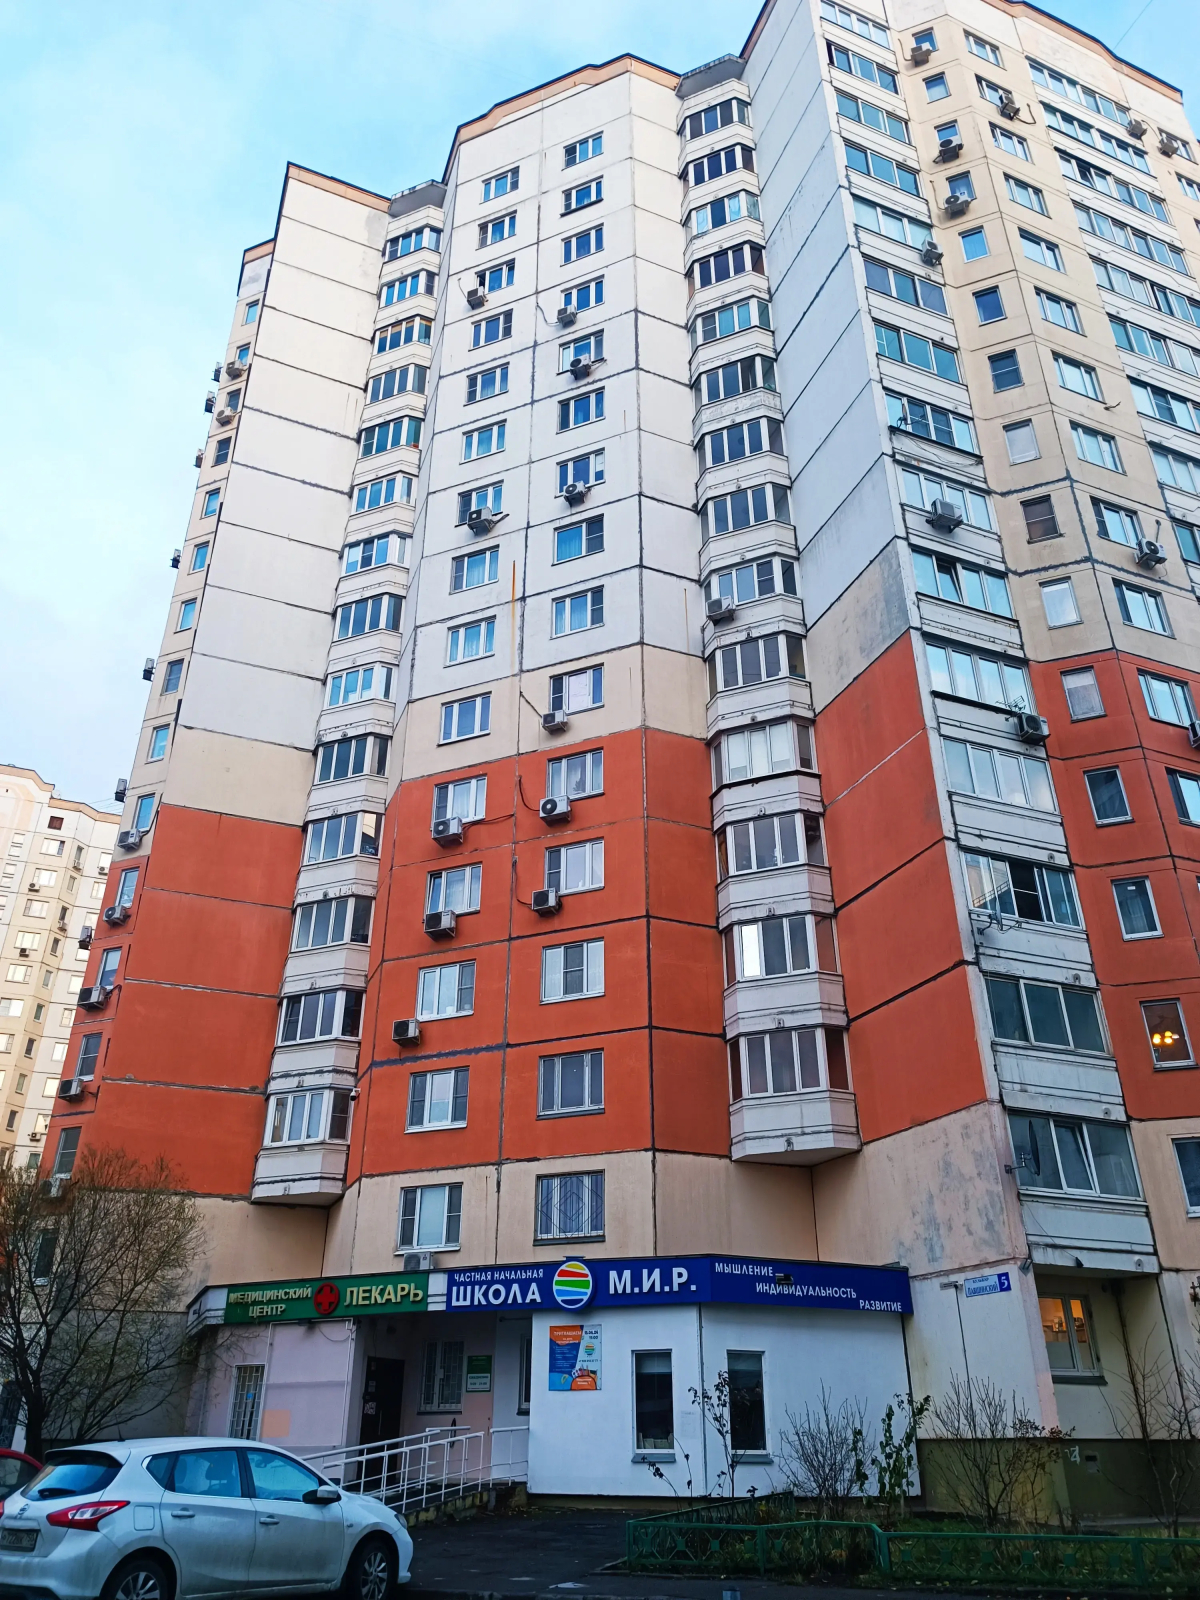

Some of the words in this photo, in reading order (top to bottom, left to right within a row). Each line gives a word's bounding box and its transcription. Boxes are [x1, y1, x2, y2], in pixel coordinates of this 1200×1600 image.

[454, 1271, 492, 1283] ЧАСТНАЯ
[494, 1269, 544, 1281] НАЧАЛЬНАЯ
[715, 1262, 774, 1276] МЫШЛЕНИЕ
[608, 1267, 697, 1295] М.И.Р.
[1001, 1276, 1008, 1289] 5
[229, 1284, 313, 1304] МЕДИЦИНСКИЙ
[344, 1282, 424, 1306] ЛЕКАРЬ
[451, 1282, 542, 1307] ШКОЛА
[756, 1282, 857, 1298] ИНДИВИДУАЛЬНОСТЬ
[249, 1304, 286, 1318] ЦЕНТР
[859, 1299, 902, 1312] РАЗВИТИЕ
